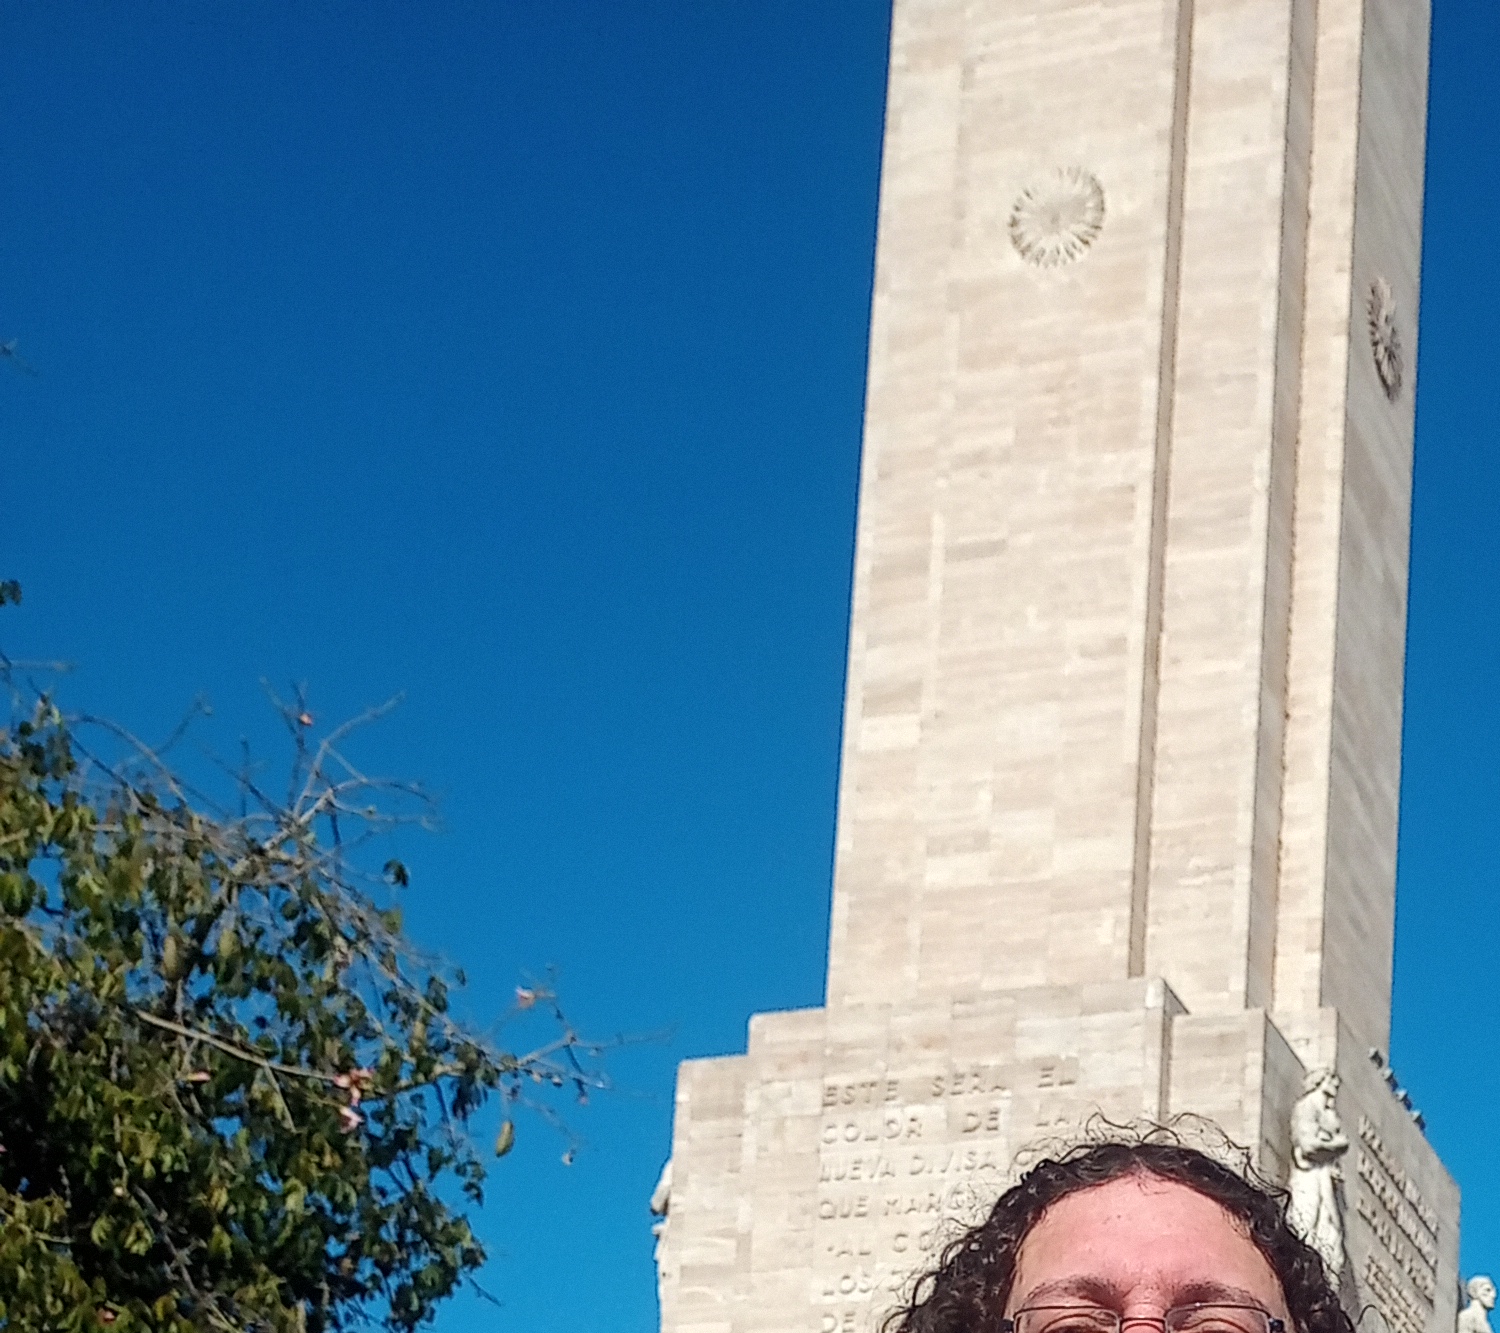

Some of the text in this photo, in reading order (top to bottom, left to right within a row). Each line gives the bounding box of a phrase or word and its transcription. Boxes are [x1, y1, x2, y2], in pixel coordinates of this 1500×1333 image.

[822, 1081, 900, 1107] ESTE
[1037, 1066, 1077, 1089] EL
[821, 1117, 923, 1144] COLOR
[962, 1109, 1000, 1133] DE
[819, 1197, 868, 1220] QUE
[822, 1274, 873, 1295] LOS
